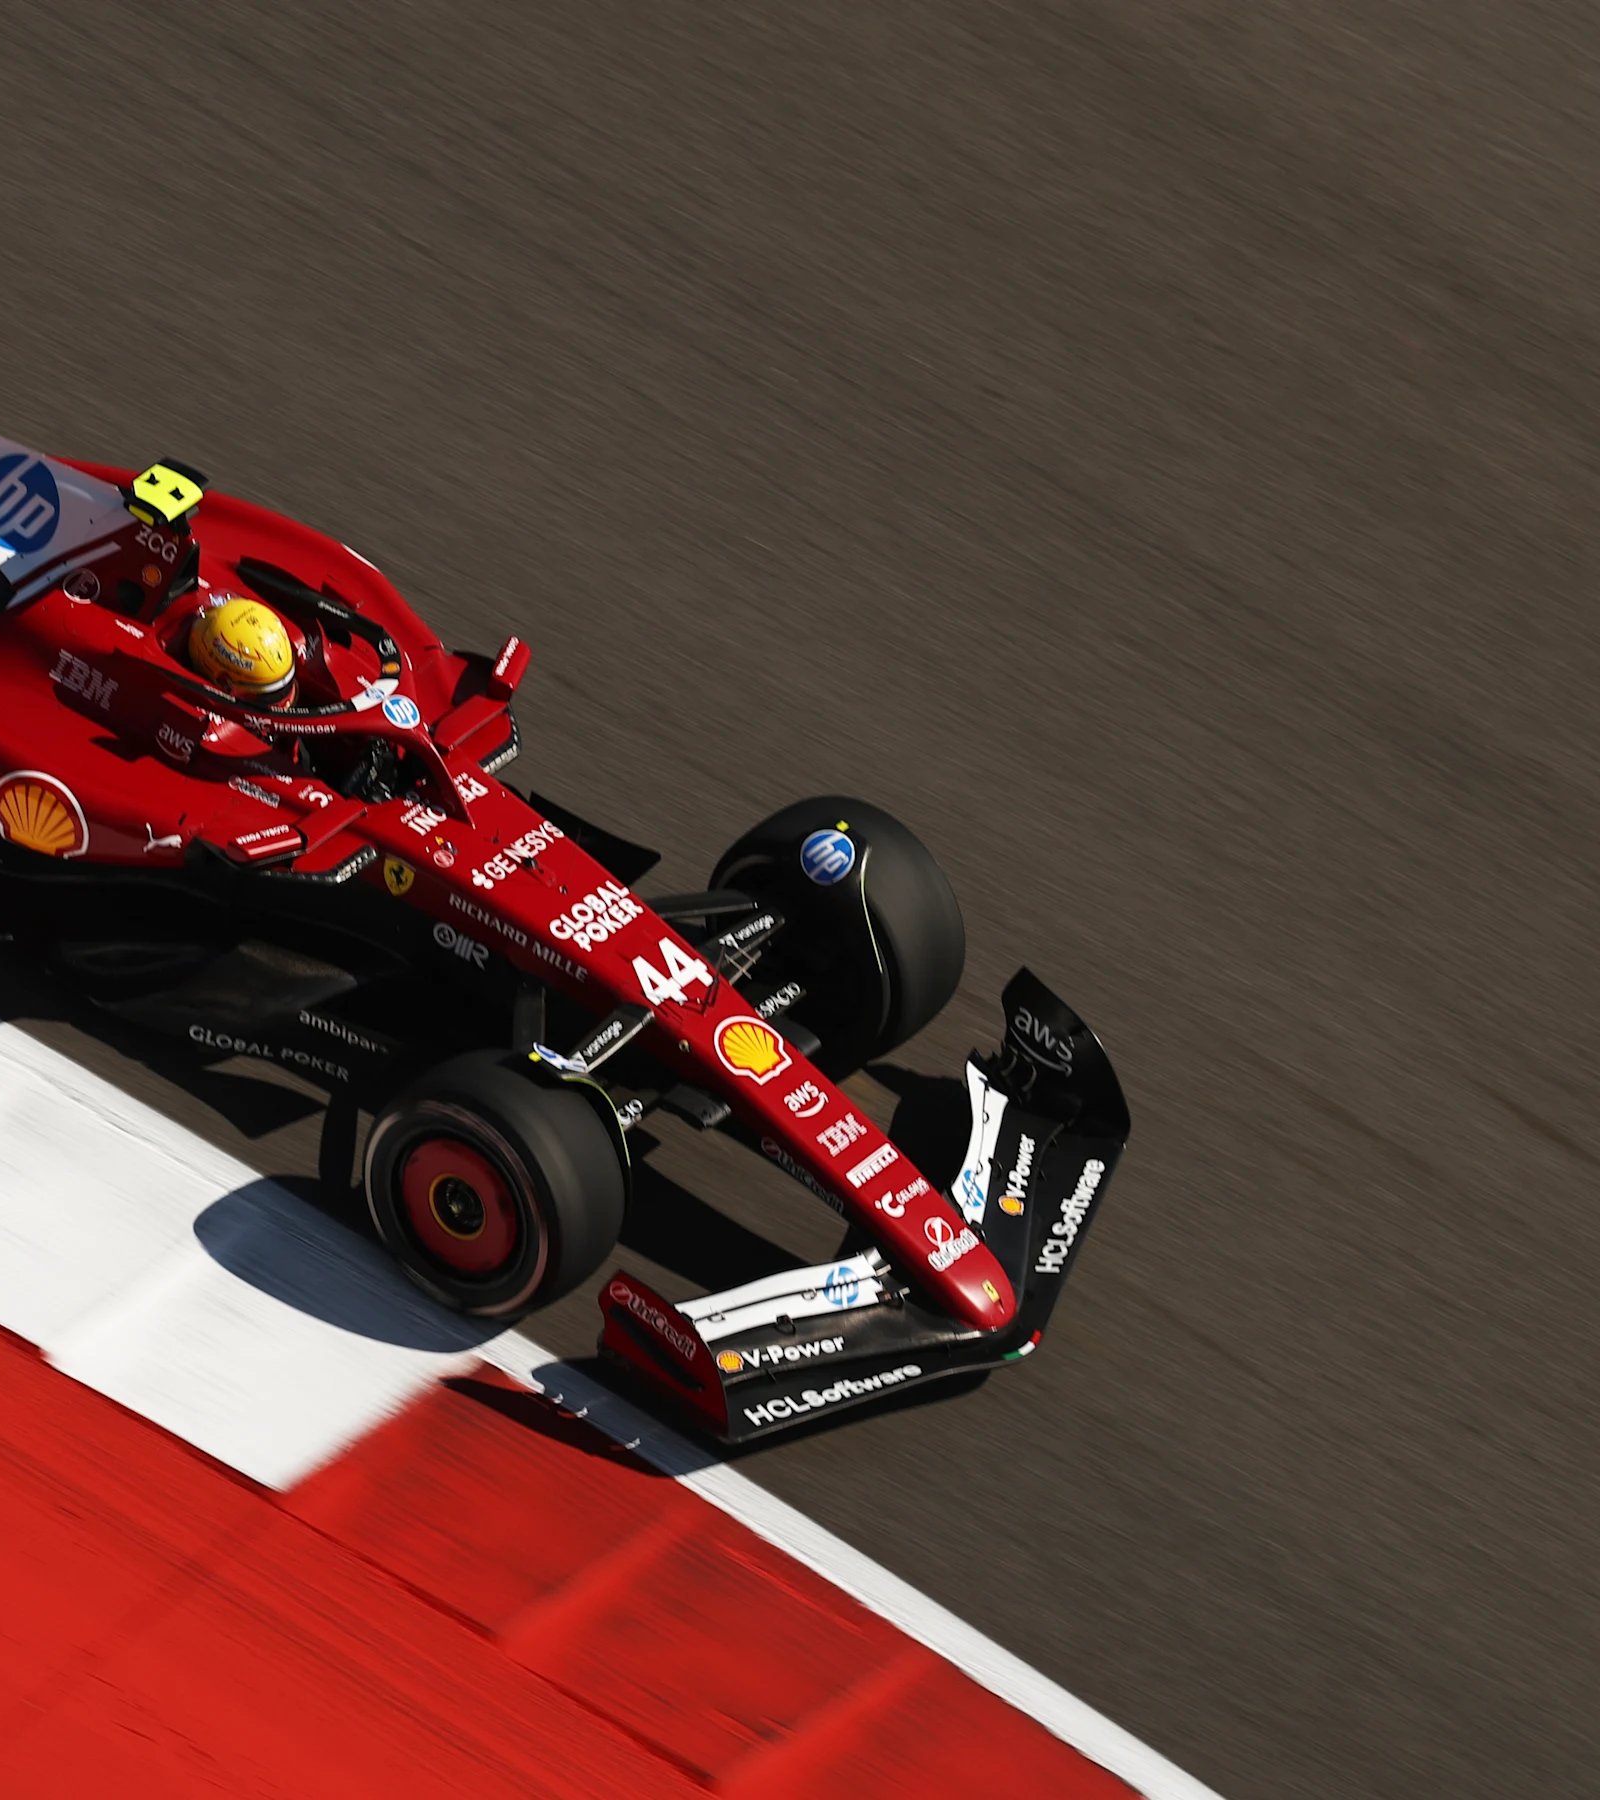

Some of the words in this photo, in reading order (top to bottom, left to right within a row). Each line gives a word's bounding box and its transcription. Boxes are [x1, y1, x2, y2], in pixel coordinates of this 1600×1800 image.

[49, 648, 120, 712] IBM
[157, 722, 195, 757] aws
[273, 721, 337, 735] TECHNOLOGY
[382, 694, 421, 730] hp
[483, 820, 565, 881] GENESYS
[800, 828, 856, 886] hp
[449, 892, 528, 948] RICHARD
[532, 940, 589, 984] MILLE
[549, 880, 631, 941] GLOBAL
[572, 898, 644, 952] POKER
[632, 936, 714, 1006] 44
[188, 1023, 275, 1058] GLOBAL
[280, 1047, 350, 1084] POKER
[1013, 1005, 1076, 1063] aws
[783, 1080, 820, 1113] aws
[816, 1112, 868, 1158] IBM
[845, 1143, 899, 1189] PIRELLI
[1005, 1133, 1036, 1200] V-Power
[927, 1227, 980, 1273] UniCredit
[627, 1291, 698, 1362] UniCredit
[742, 1335, 846, 1370] V-Power
[742, 1363, 923, 1427] HCLSoftware
